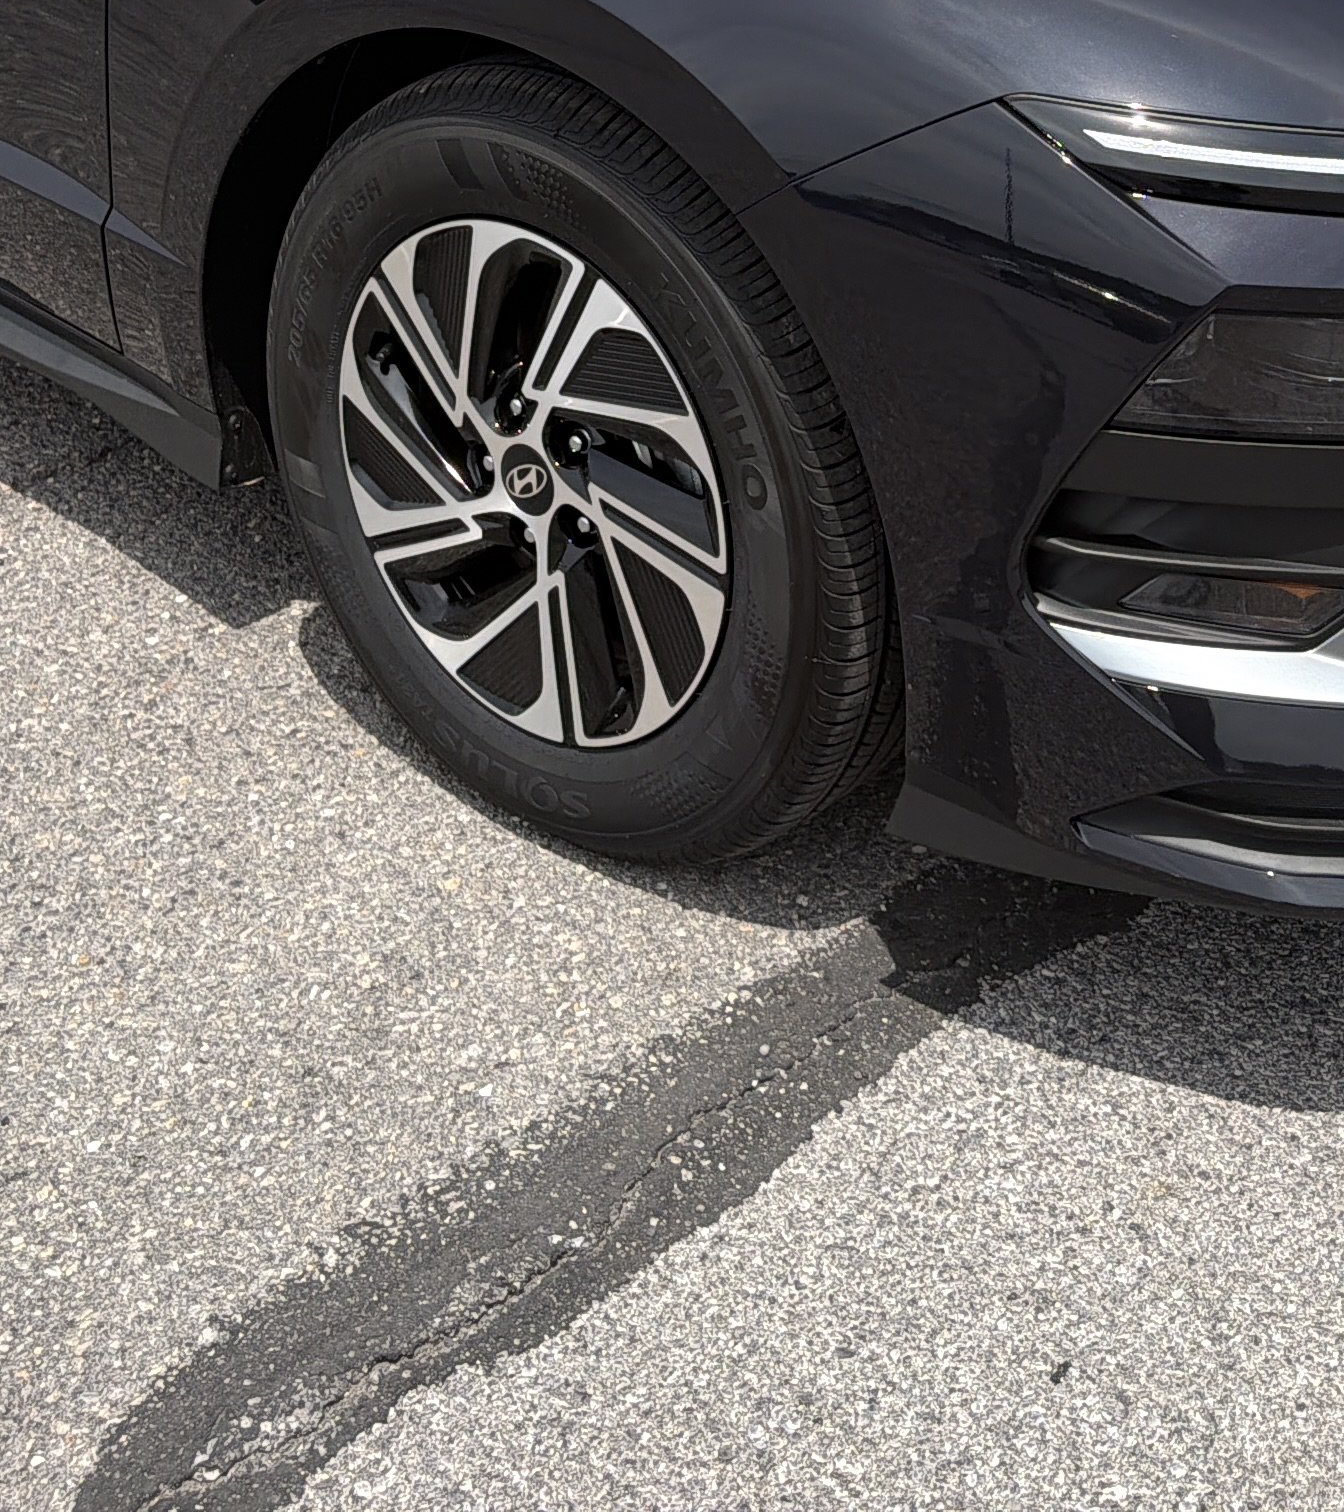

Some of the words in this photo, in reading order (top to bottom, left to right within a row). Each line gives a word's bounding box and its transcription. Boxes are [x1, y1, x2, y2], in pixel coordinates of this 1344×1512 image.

[342, 176, 384, 223] 95H
[656, 272, 768, 510] KUMHO
[432, 721, 591, 819] SOLUS
